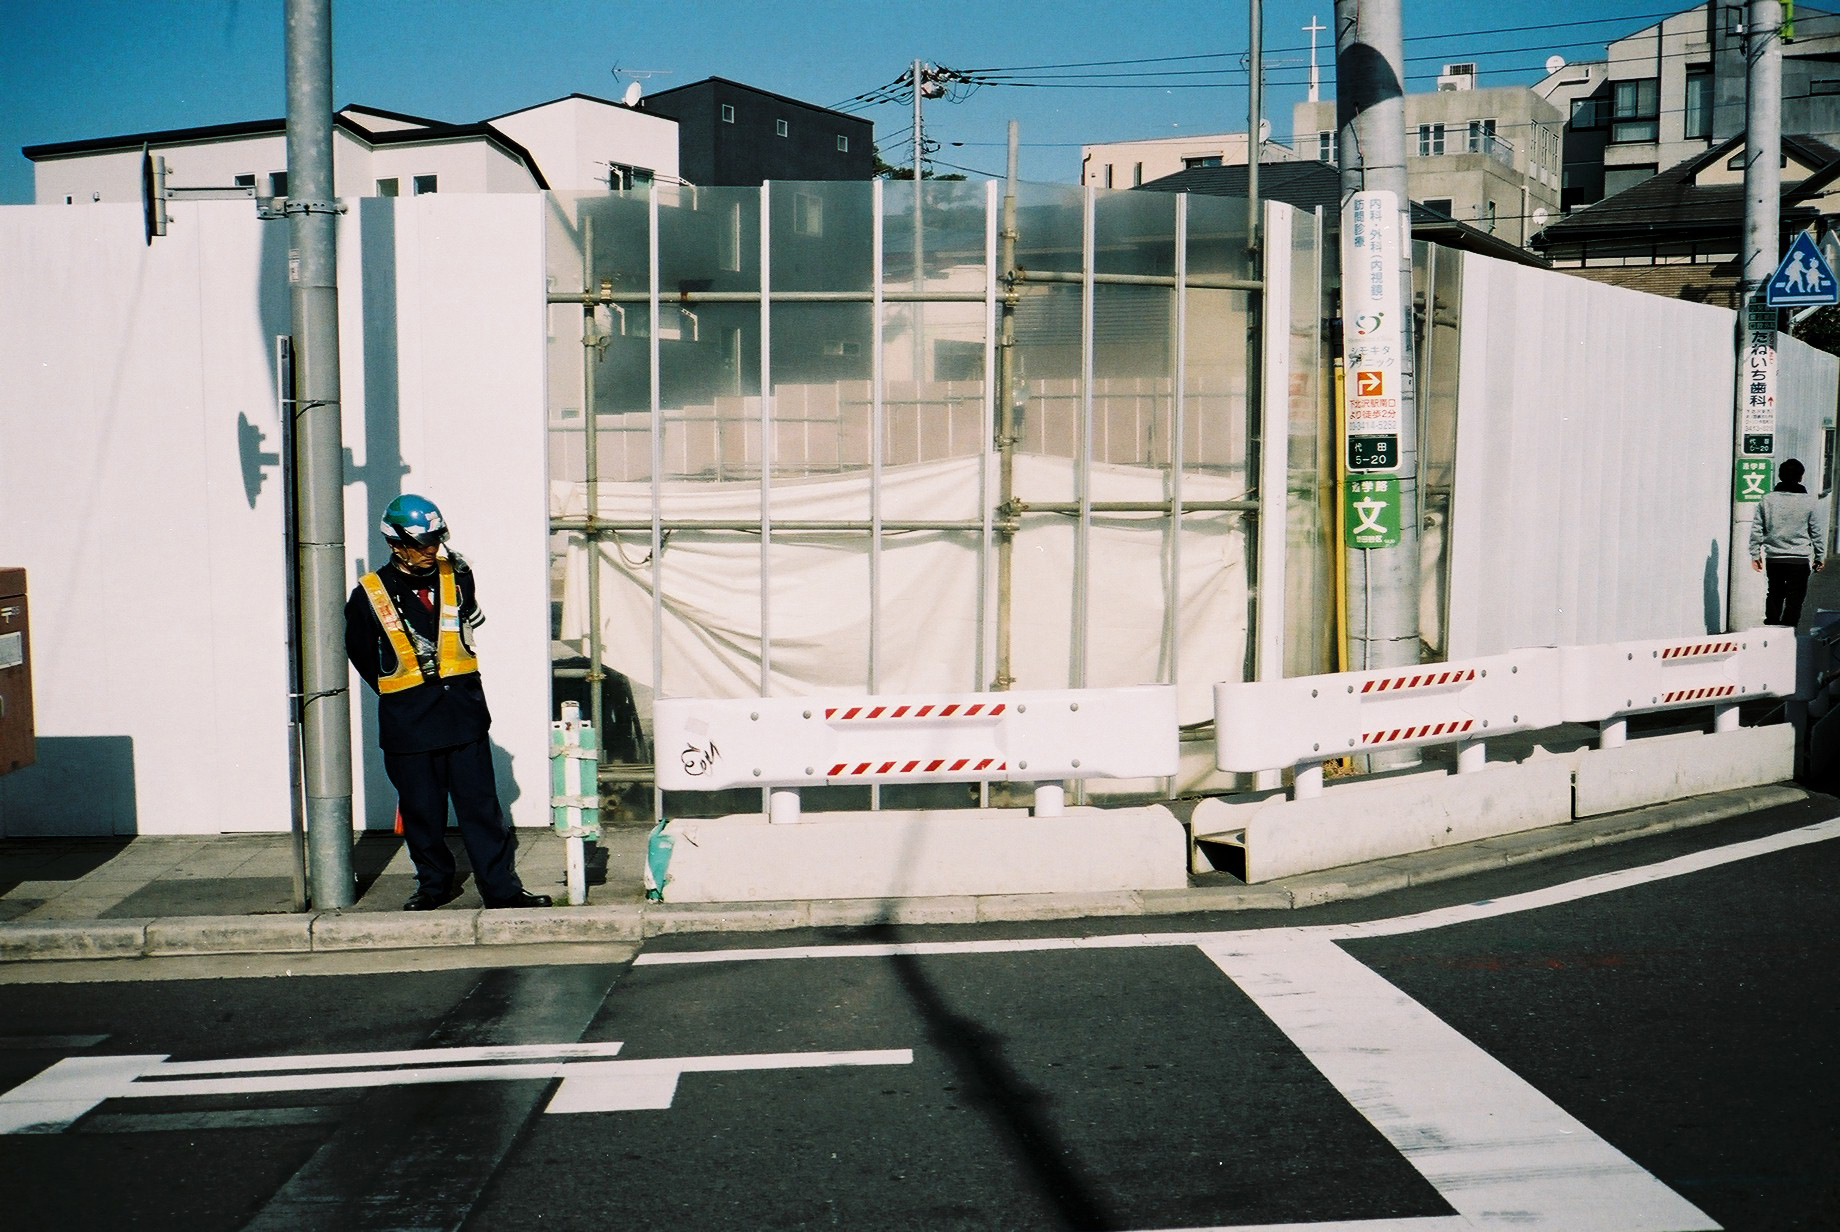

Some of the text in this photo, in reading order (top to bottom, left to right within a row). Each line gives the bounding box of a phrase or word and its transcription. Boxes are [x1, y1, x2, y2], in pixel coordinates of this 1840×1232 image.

[1354, 199, 1365, 248] 訪問診療
[1350, 345, 1390, 356] シモキタ
[1749, 331, 1768, 407] たねいち歯科
[1355, 454, 1387, 465] 5-20
[1742, 471, 1766, 494] 文
[1353, 496, 1387, 534] 文
